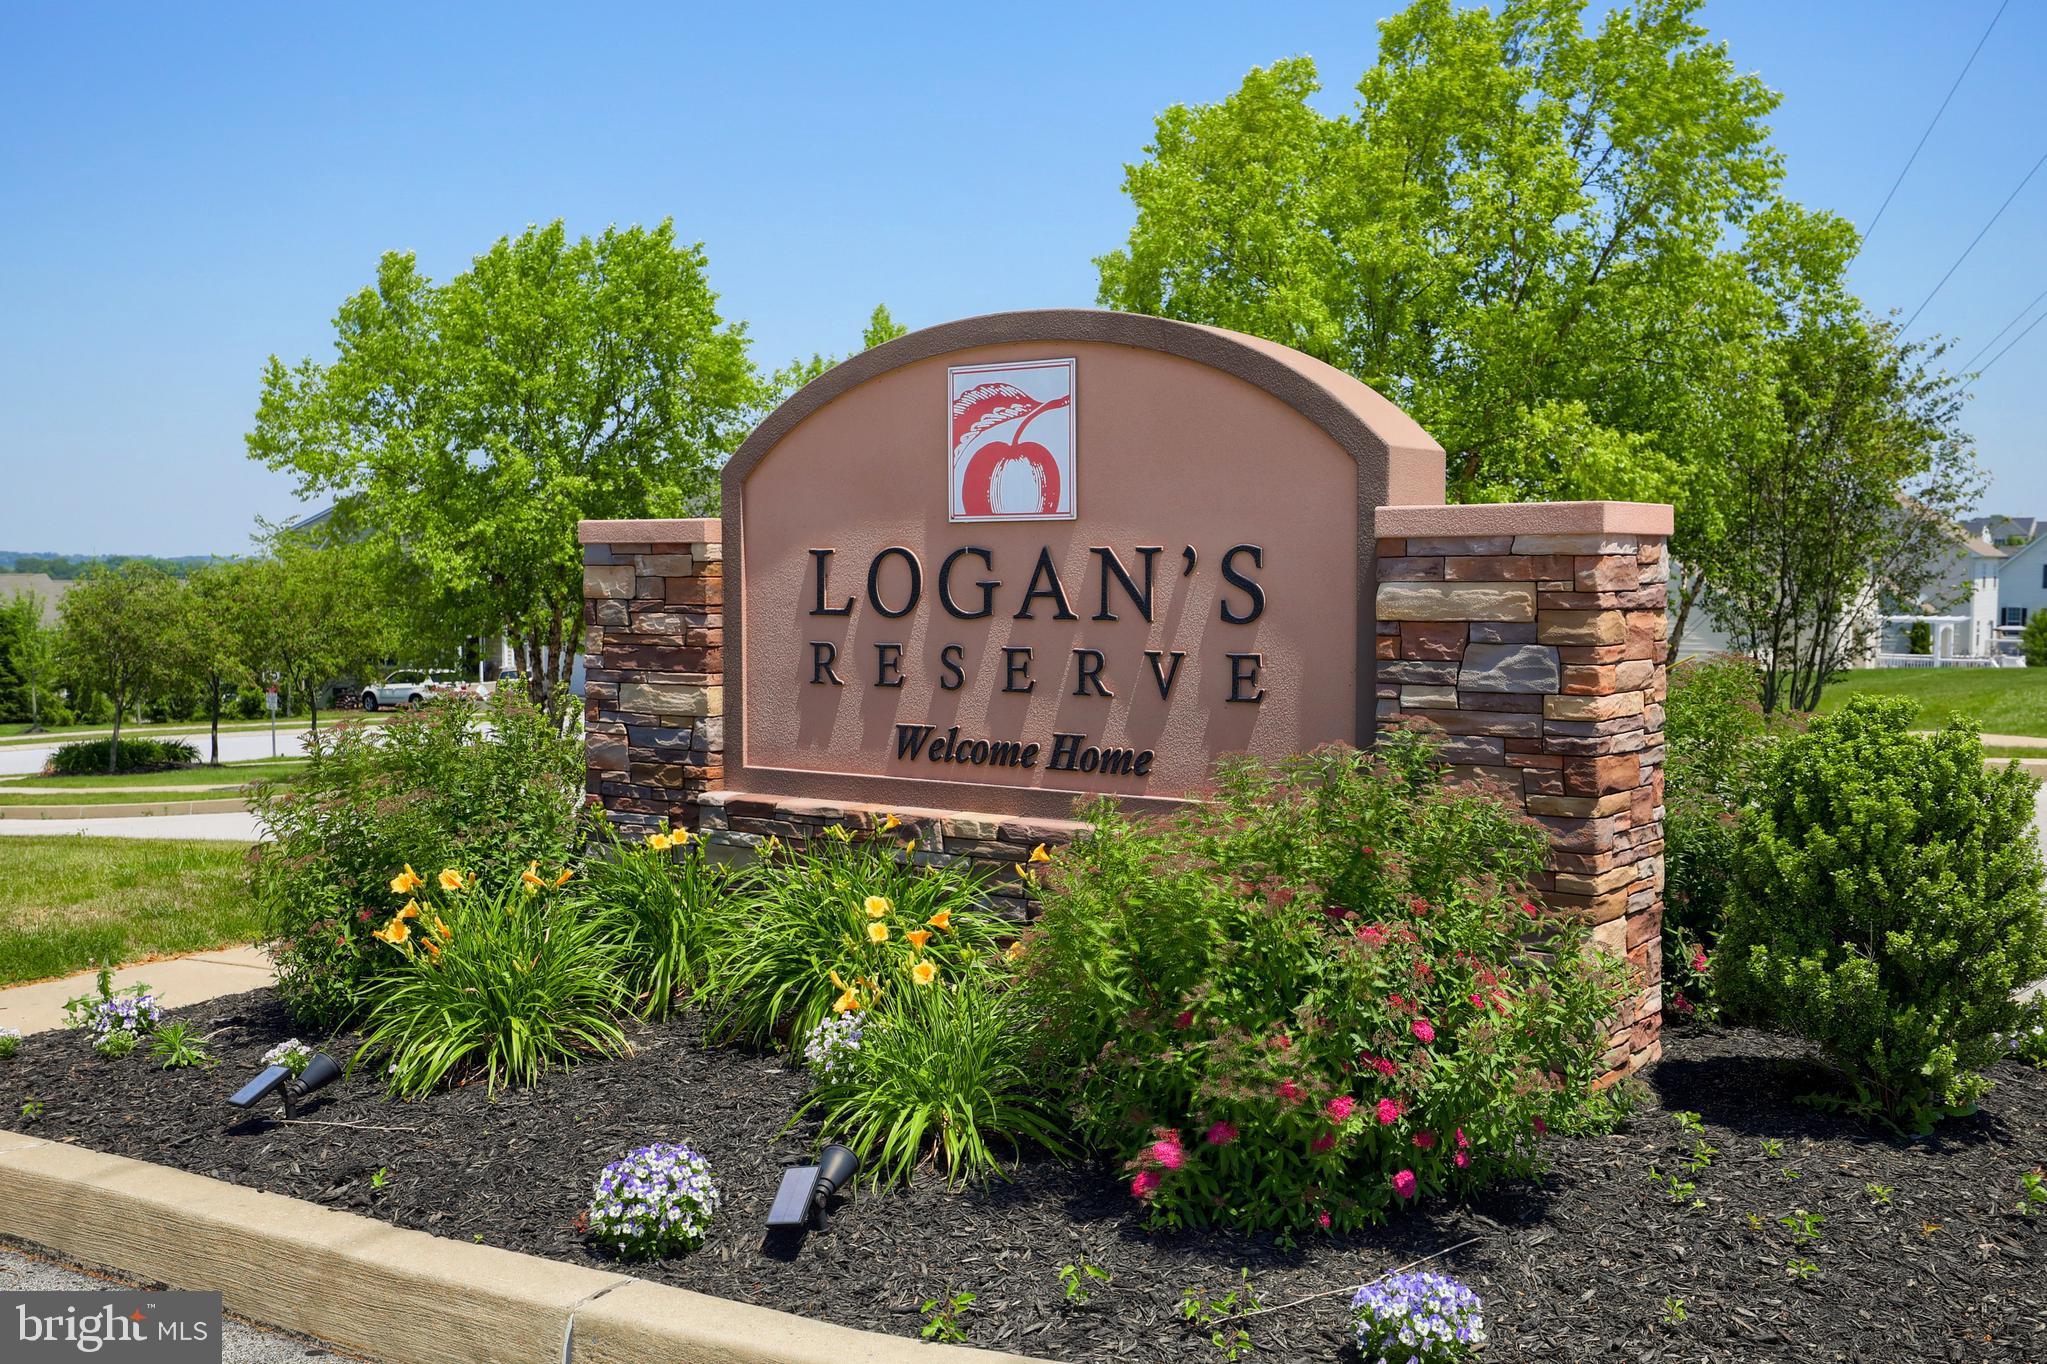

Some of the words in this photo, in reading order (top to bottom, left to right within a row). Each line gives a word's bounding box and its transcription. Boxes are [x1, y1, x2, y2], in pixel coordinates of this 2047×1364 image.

[808, 544, 1267, 625] LOGAN'S
[809, 641, 1267, 703] RESERVE
[896, 723, 1041, 768] Welcome
[1045, 732, 1155, 776] Home
